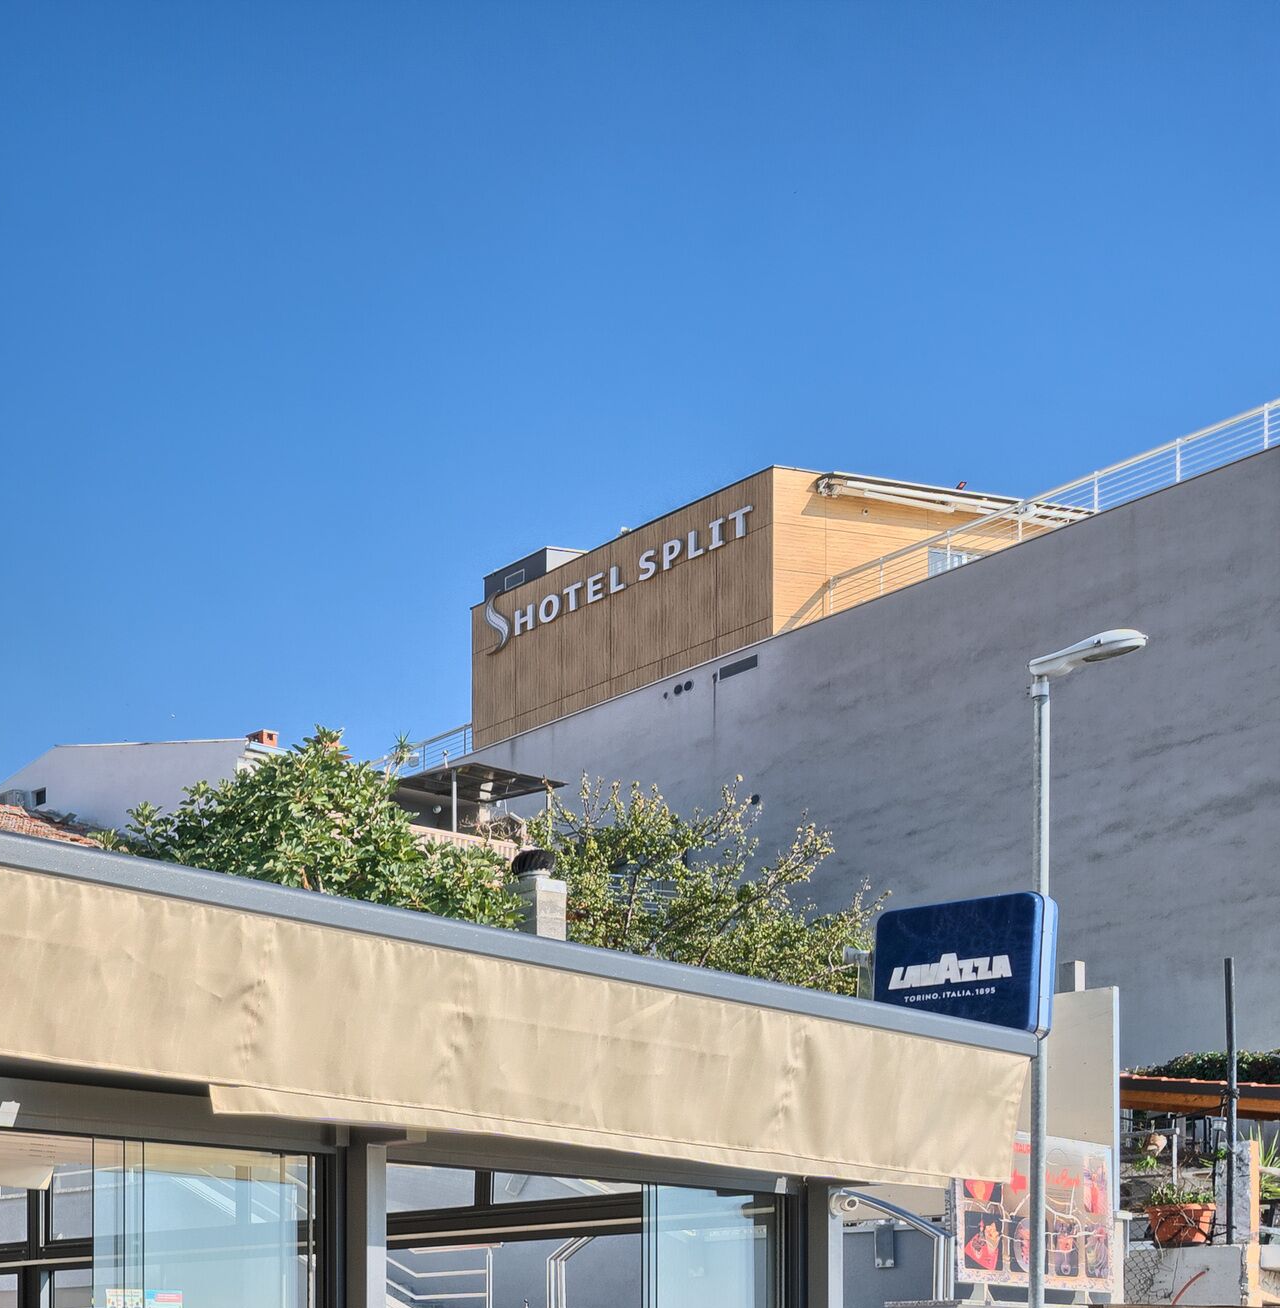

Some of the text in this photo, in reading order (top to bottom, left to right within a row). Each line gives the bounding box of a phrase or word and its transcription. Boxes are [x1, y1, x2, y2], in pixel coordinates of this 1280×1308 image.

[513, 566, 627, 637] HOTEL
[638, 505, 754, 581] SPLIT
[888, 952, 1013, 991] LAVAZZA
[975, 986, 996, 996] 1895
